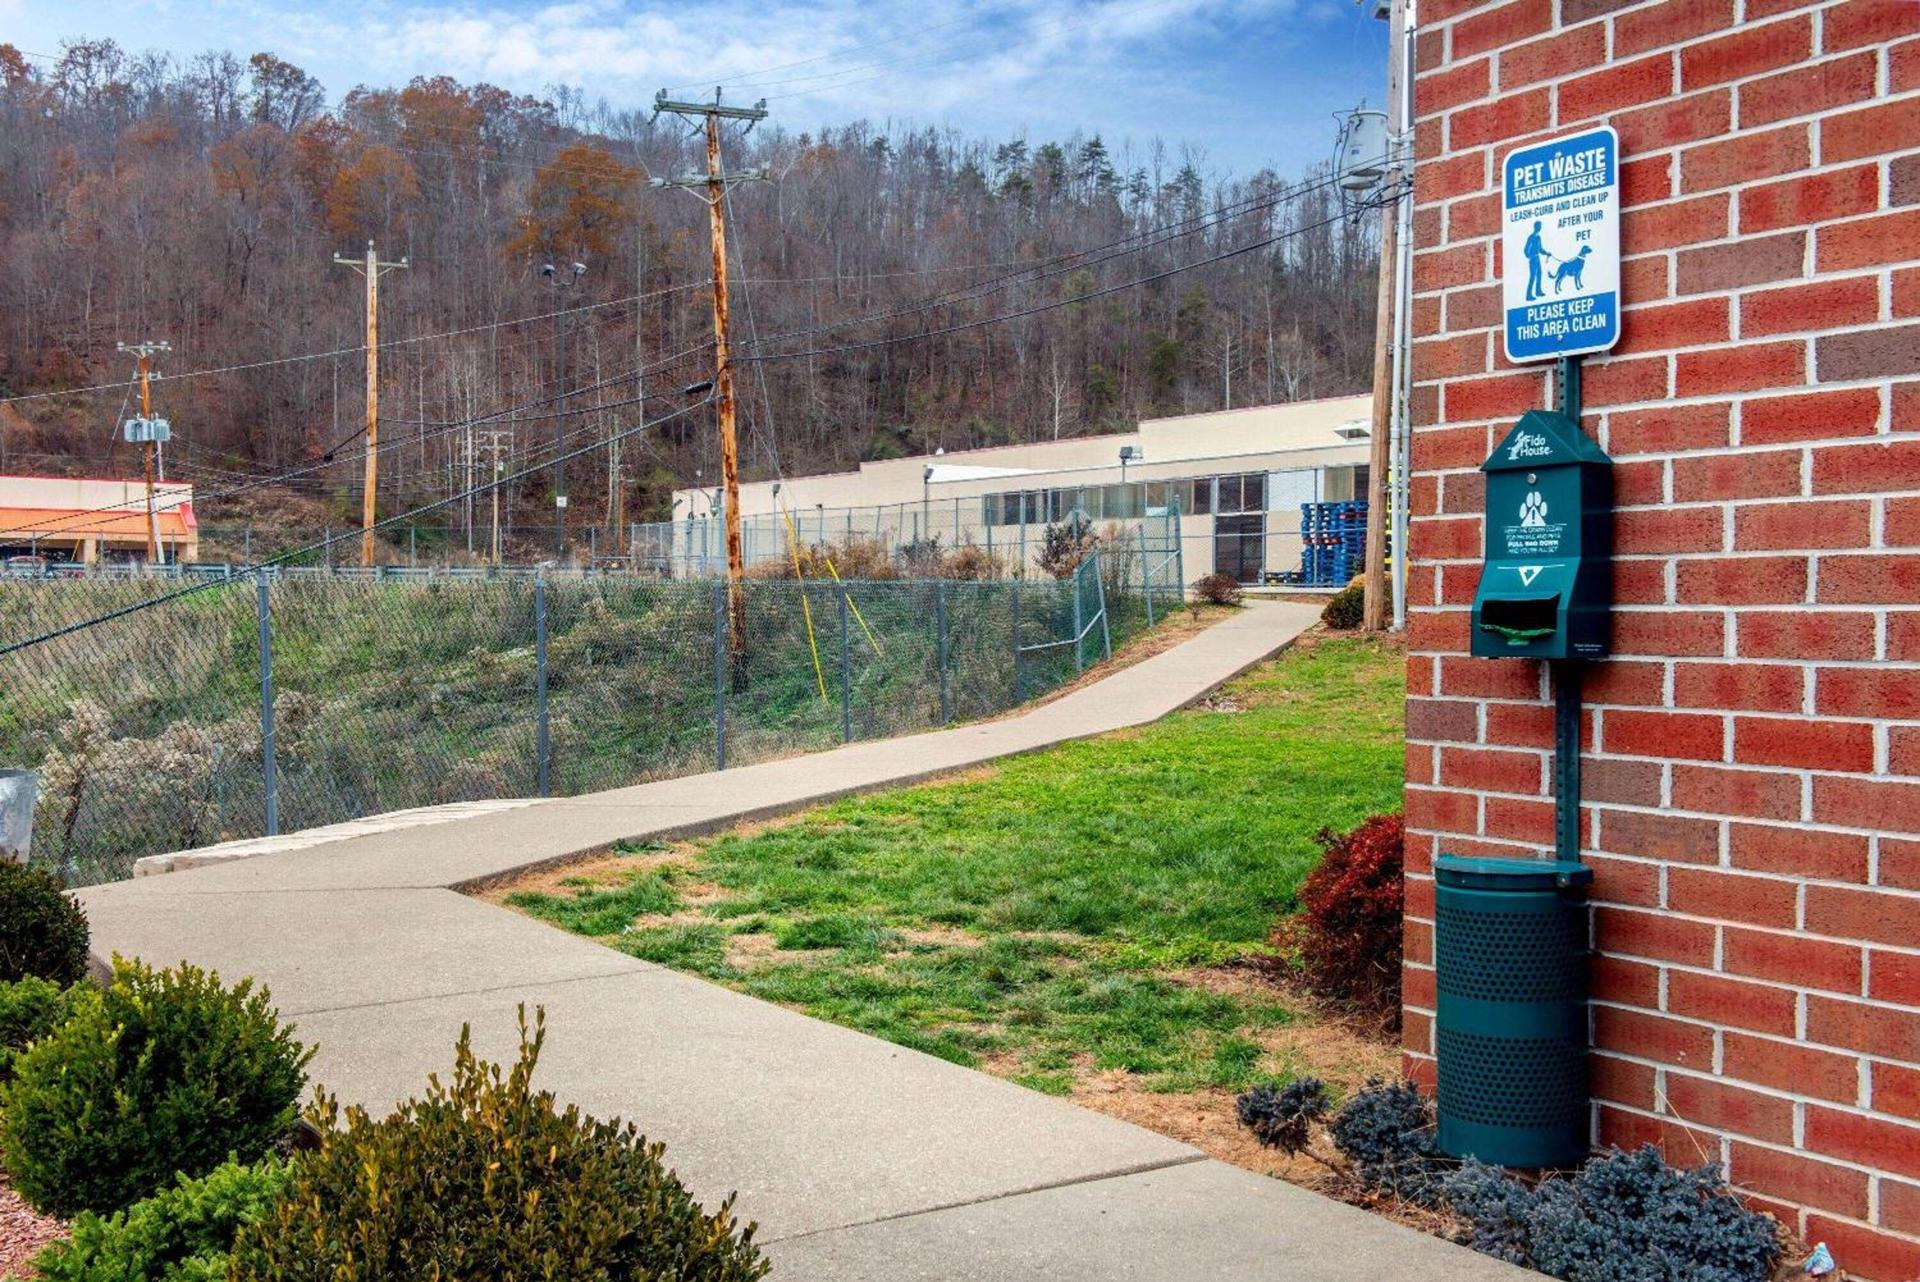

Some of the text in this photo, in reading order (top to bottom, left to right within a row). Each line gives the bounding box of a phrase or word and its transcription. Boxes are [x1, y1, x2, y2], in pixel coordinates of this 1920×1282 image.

[1514, 147, 1606, 188] PET WASTE
[1514, 171, 1606, 205] TRANSMITS DISEASE
[1510, 191, 1609, 222] LEASH-CURB AND CLEAN UP
[1558, 210, 1603, 228] AFTER YOUR
[1576, 229, 1591, 241] PET
[1527, 298, 1594, 322] PLEASE KEEP
[1517, 313, 1606, 340] THIS AREA CLEAN
[1520, 433, 1546, 448] Fido
[1520, 446, 1552, 457] House
